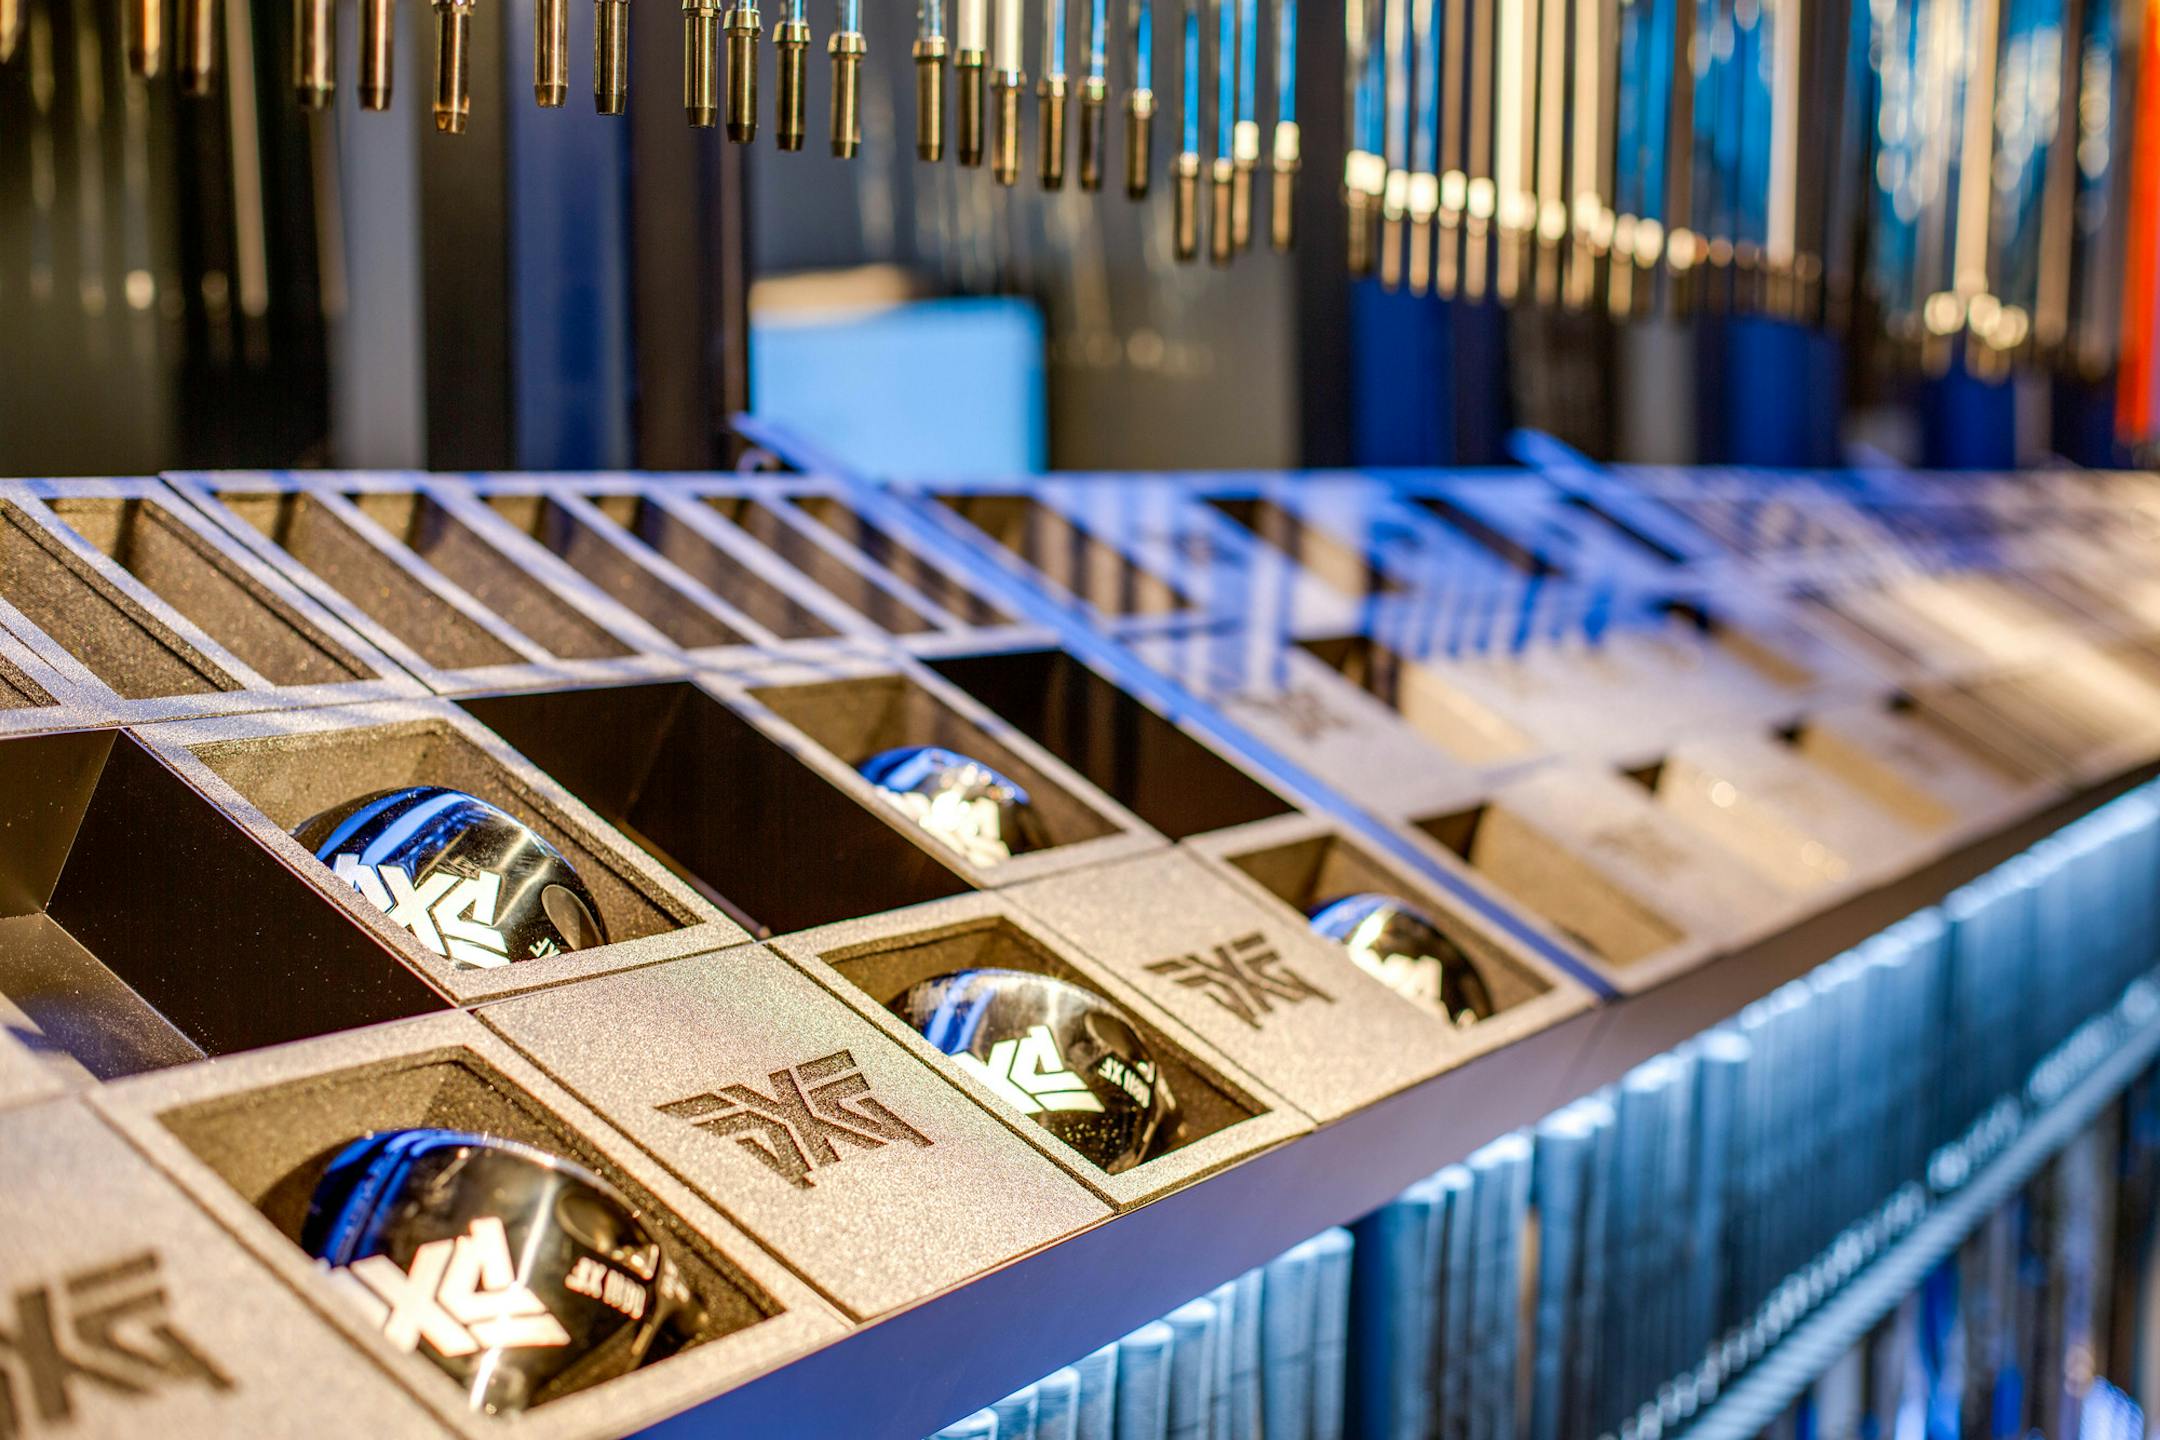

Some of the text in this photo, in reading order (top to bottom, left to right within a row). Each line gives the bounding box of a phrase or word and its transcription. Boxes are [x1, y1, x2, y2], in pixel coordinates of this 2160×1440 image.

[1142, 931, 1337, 1031] PXG
[654, 1049, 935, 1189] PXG
[0, 1251, 237, 1440] XG
